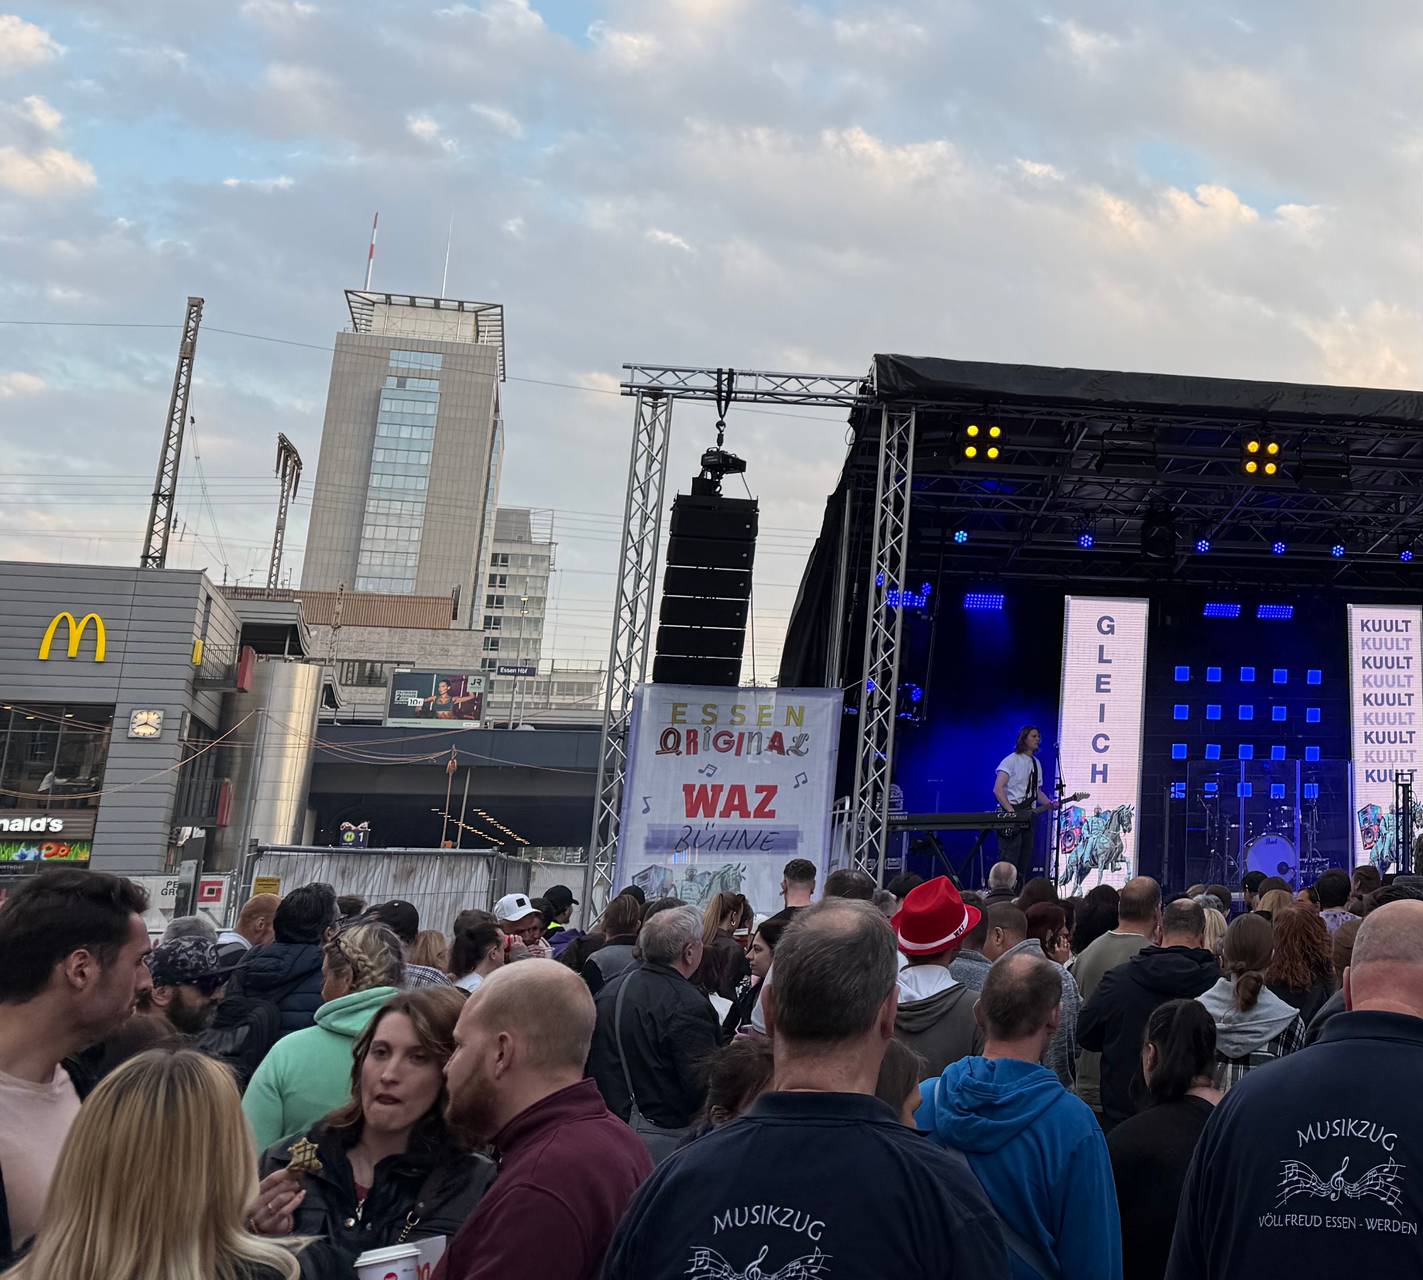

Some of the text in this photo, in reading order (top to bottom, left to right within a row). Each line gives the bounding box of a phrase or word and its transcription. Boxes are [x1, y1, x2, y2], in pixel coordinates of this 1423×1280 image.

[1361, 620, 1411, 632] KUULT
[1361, 638, 1412, 650] KUULT
[1362, 656, 1413, 669] KUULT
[1362, 674, 1414, 688] KUULT
[1090, 615, 1116, 784] GLEICH
[1363, 693, 1414, 706] KUULT
[671, 703, 806, 726] ESSEN
[1363, 712, 1415, 725] KUULT
[1364, 731, 1416, 744] KUULT
[1364, 750, 1417, 763] KUULT
[682, 783, 779, 819] WAZ
[359, 831, 364, 842] 1
[673, 822, 780, 853] BÜHNE
[166, 881, 179, 889] PE
[161, 888, 178, 896] GR
[1297, 1118, 1398, 1151] MUSIKZUG
[713, 1205, 826, 1241] MUSIKZUG
[1285, 1214, 1322, 1227] FREUD
[1325, 1216, 1356, 1229] ESSEN
[1365, 1218, 1418, 1235] WERDEN
